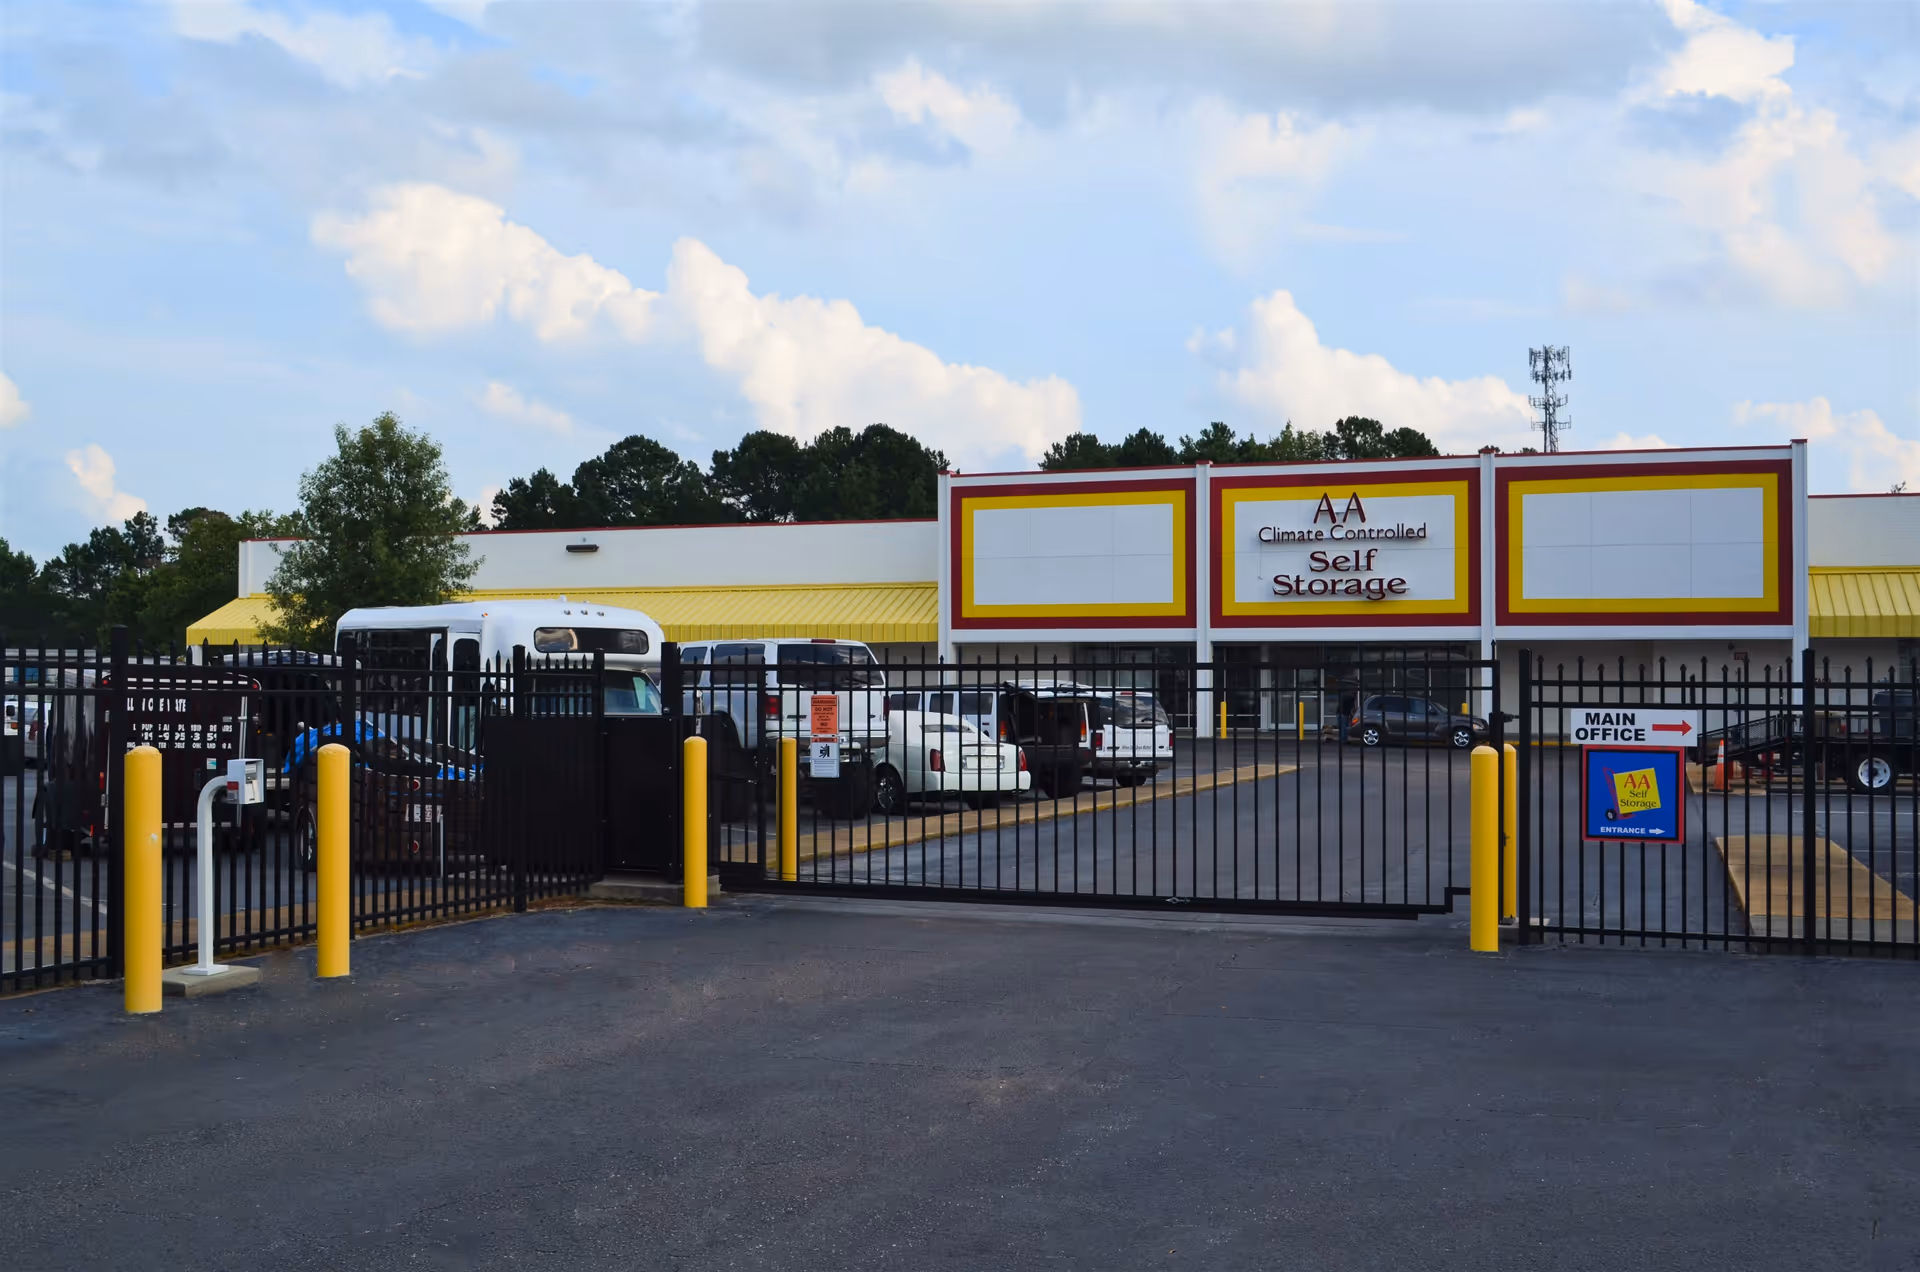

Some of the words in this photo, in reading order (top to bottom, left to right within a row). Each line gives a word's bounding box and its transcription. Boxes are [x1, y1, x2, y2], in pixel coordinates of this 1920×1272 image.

[1313, 492, 1366, 524] AA
[1258, 526, 1324, 543] Climate
[1330, 522, 1427, 541] Controlled
[1309, 548, 1378, 573] Self
[1272, 574, 1407, 600] Storage
[1585, 712, 1636, 726] MAIN
[1575, 727, 1646, 741] OFFICE
[1623, 773, 1651, 790] AA
[1629, 789, 1648, 798] Self
[1619, 798, 1657, 809] Storage
[1600, 826, 1646, 834] ENTRANCE
